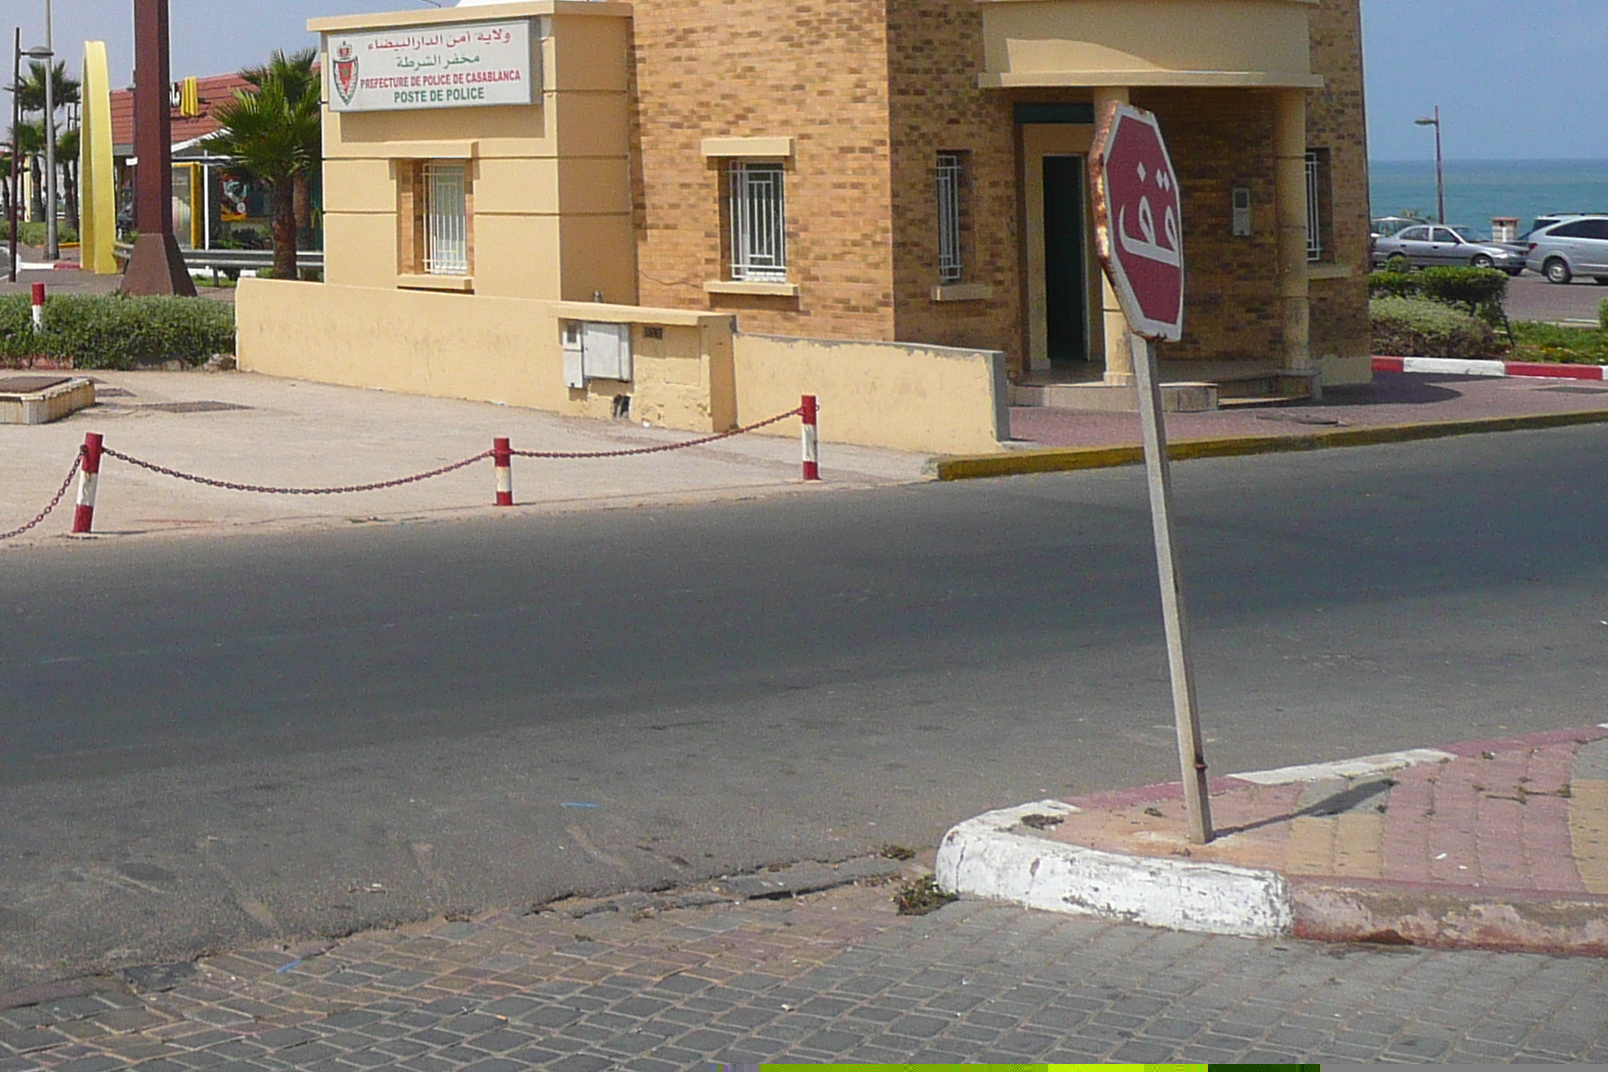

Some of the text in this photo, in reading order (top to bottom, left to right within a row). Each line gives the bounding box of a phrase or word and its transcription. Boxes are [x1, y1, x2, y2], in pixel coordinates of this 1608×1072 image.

[477, 28, 511, 45] ولاية
[396, 55, 441, 71] الشرطة
[360, 70, 521, 89] PREFECTURE DE POLICE DE CASABLANCA
[394, 87, 485, 103] POSTE DE POLICE
[1119, 161, 1181, 268] قف
